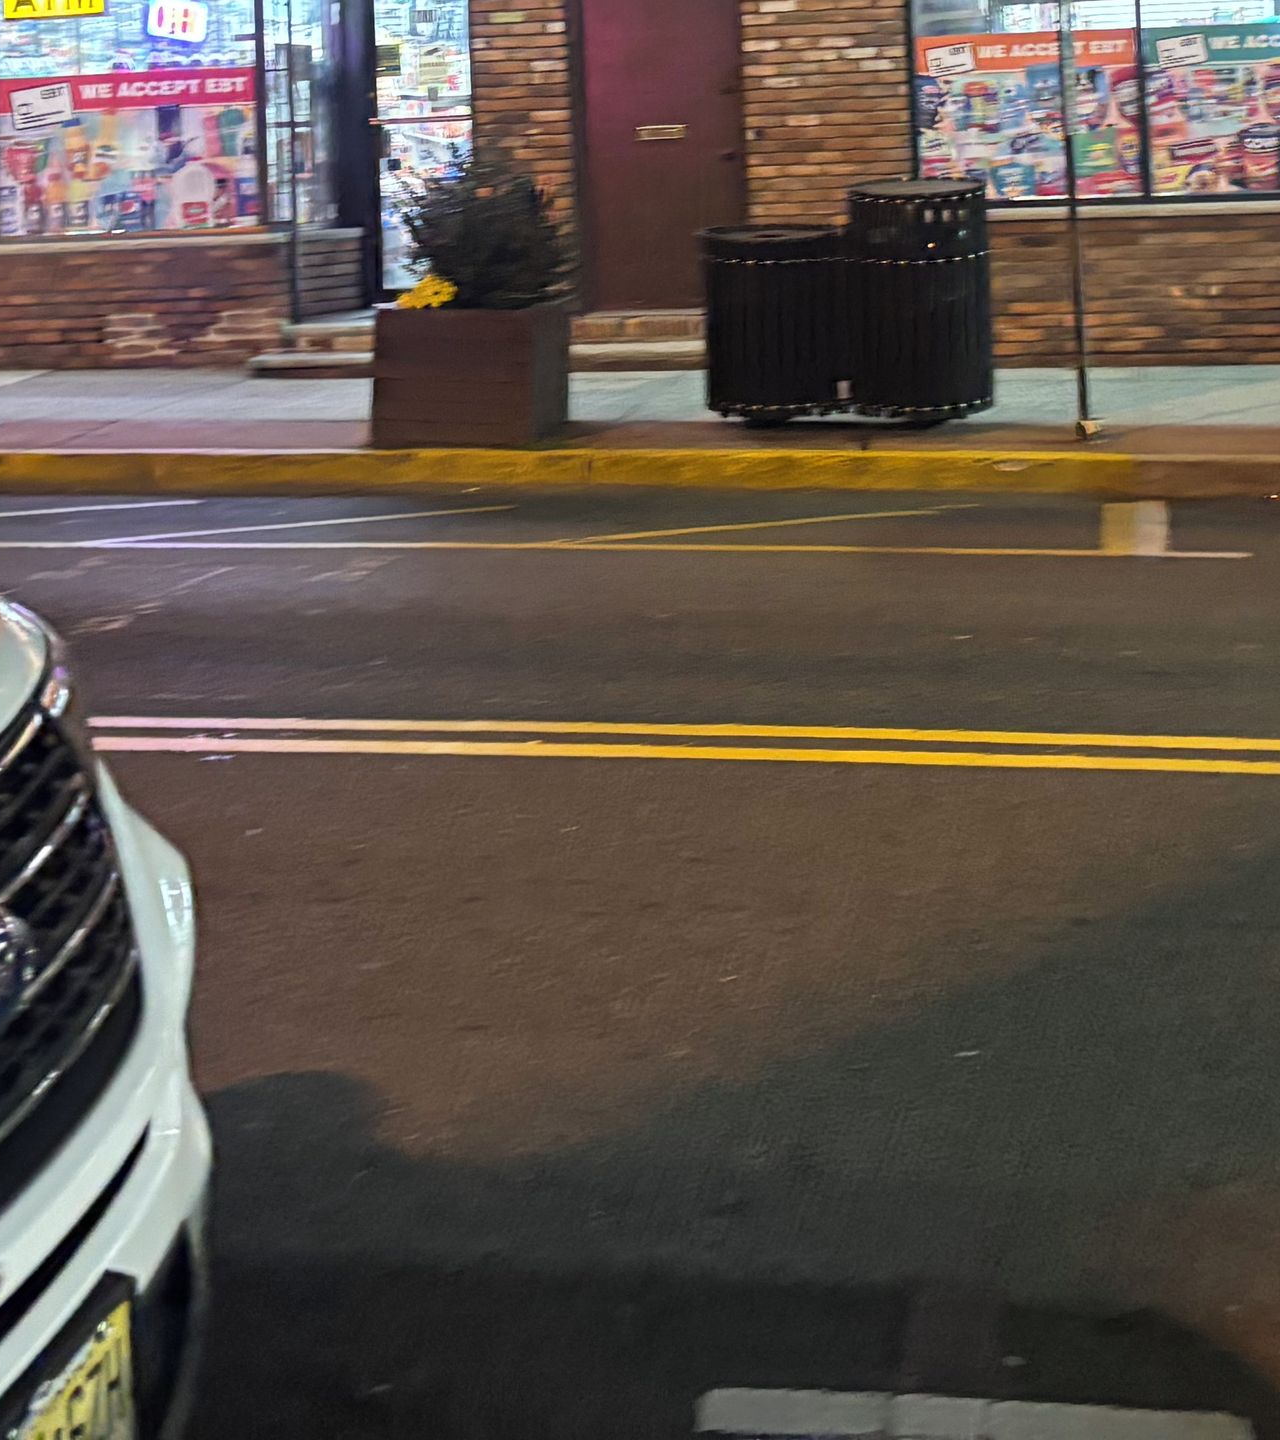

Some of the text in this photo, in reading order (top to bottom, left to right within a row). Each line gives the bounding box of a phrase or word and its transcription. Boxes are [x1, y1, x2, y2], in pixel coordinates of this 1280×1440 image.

[1009, 40, 1086, 58] ACCET
[79, 82, 114, 101] WE
[116, 78, 199, 99] ACCEPT
